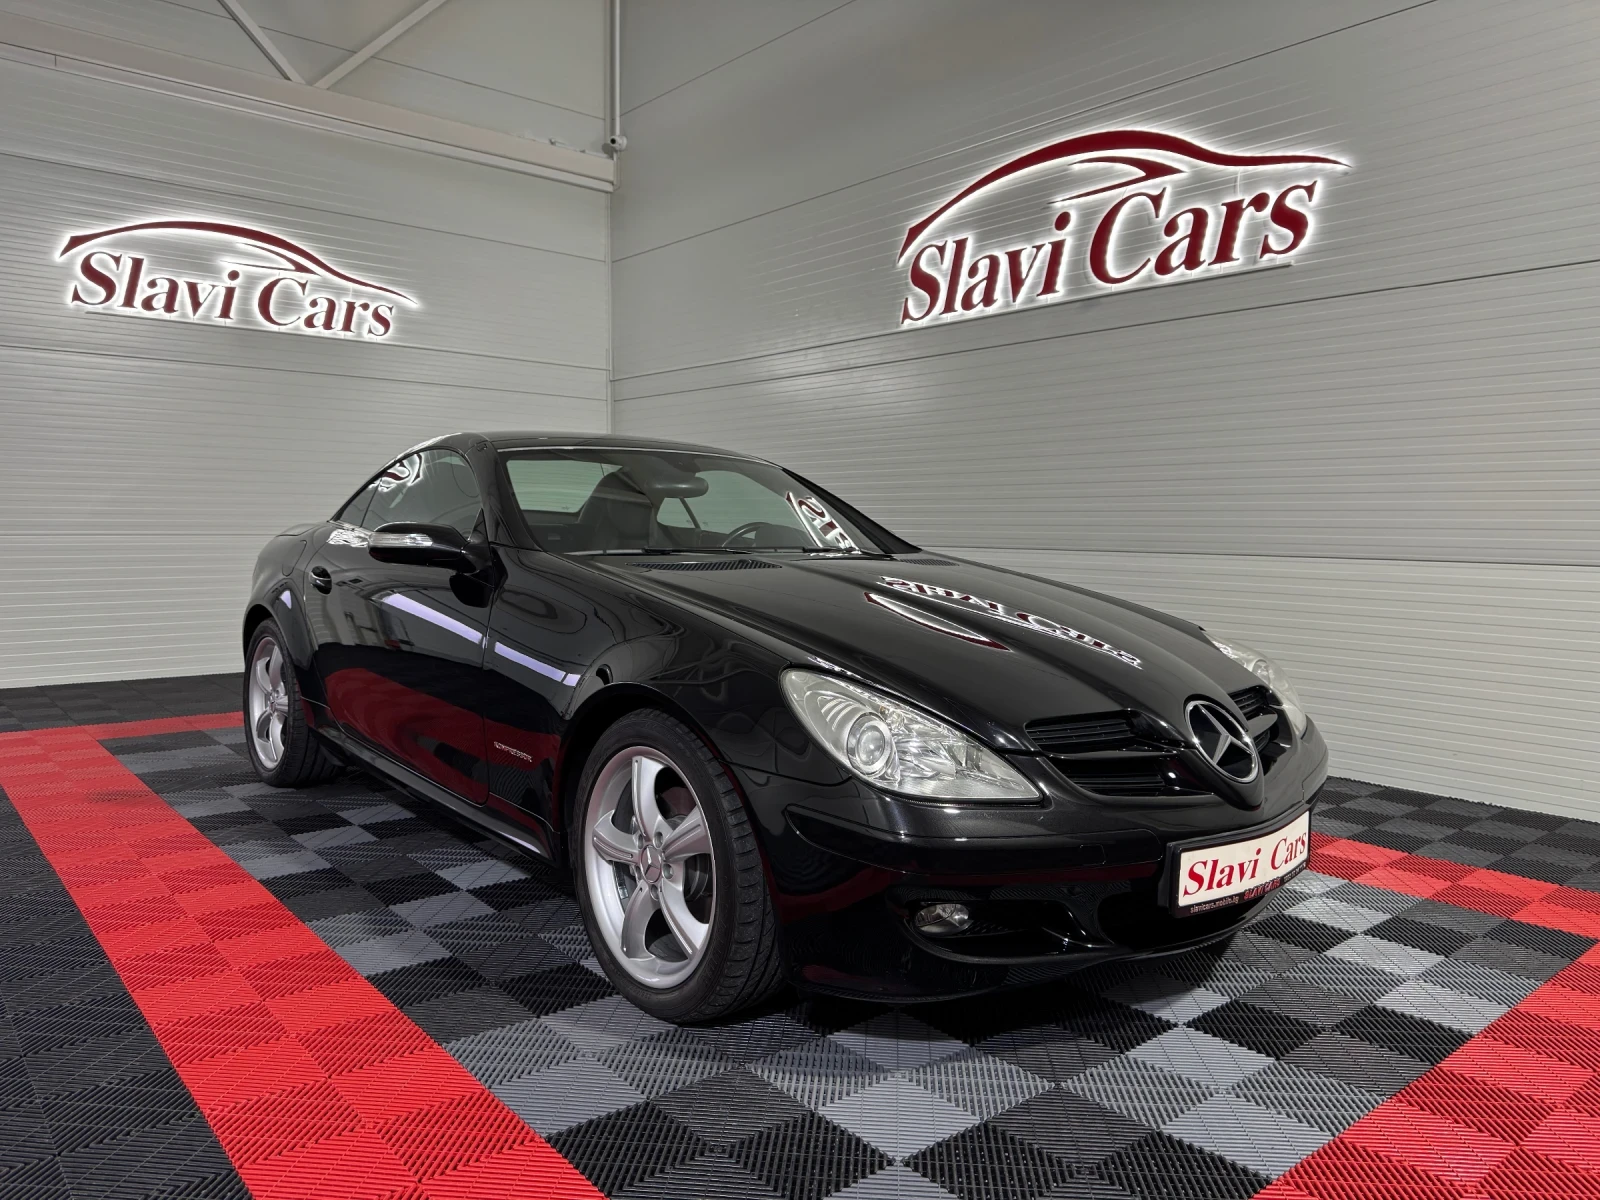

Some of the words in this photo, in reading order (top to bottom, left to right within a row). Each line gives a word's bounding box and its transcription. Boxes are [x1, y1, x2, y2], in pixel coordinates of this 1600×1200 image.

[71, 251, 239, 320] Slavi
[257, 277, 395, 338] Cars
[901, 211, 1073, 325] Slavi
[1089, 180, 1318, 285] Cars
[1183, 848, 1262, 898] Slavi
[1270, 832, 1307, 871] Cars
